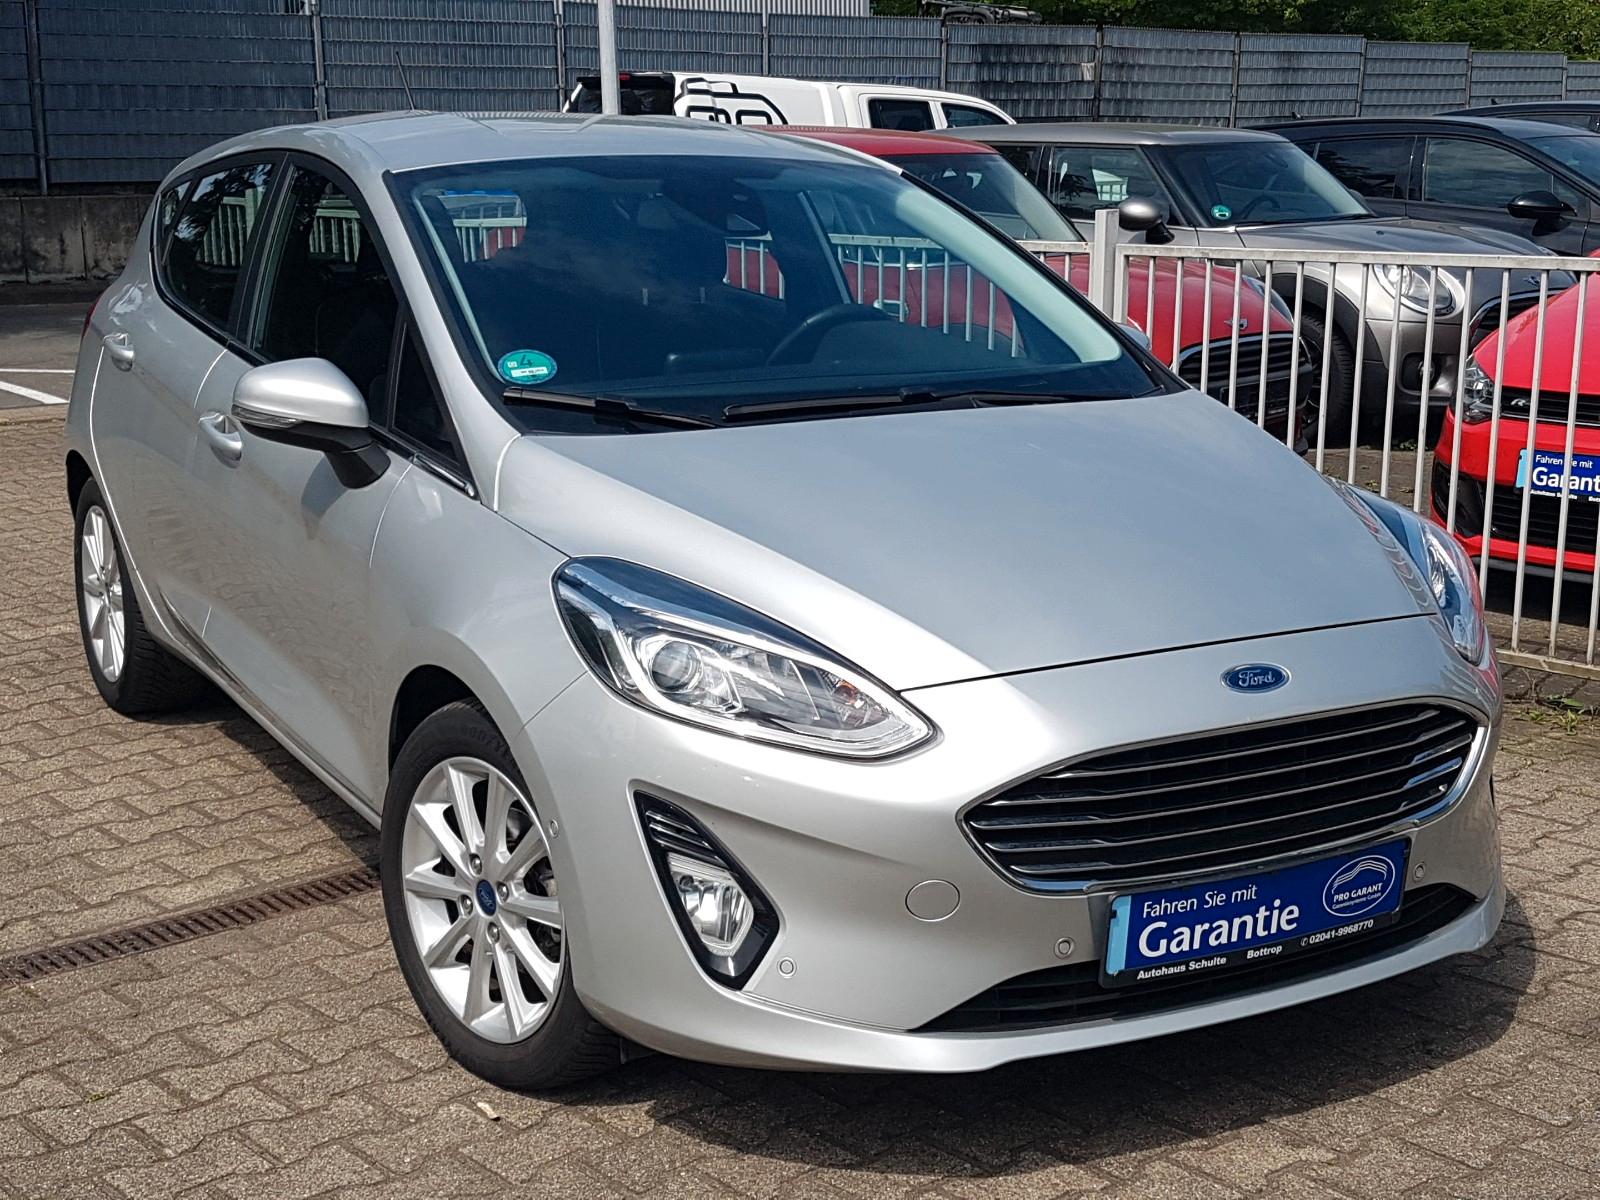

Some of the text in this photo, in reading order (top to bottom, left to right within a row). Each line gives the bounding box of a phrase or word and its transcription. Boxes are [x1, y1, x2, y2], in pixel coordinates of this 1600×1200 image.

[1535, 454, 1563, 466] Fahren
[1579, 460, 1594, 469] mit
[1238, 669, 1276, 687] Ford
[1142, 884, 1258, 918] Fahren Sie mit
[1333, 891, 1350, 903] PRO
[1351, 882, 1383, 898] GARANT
[1138, 898, 1300, 958] Garantie
[1136, 919, 1374, 980] Autohaus Schulte Bottrop 02041-9968770
